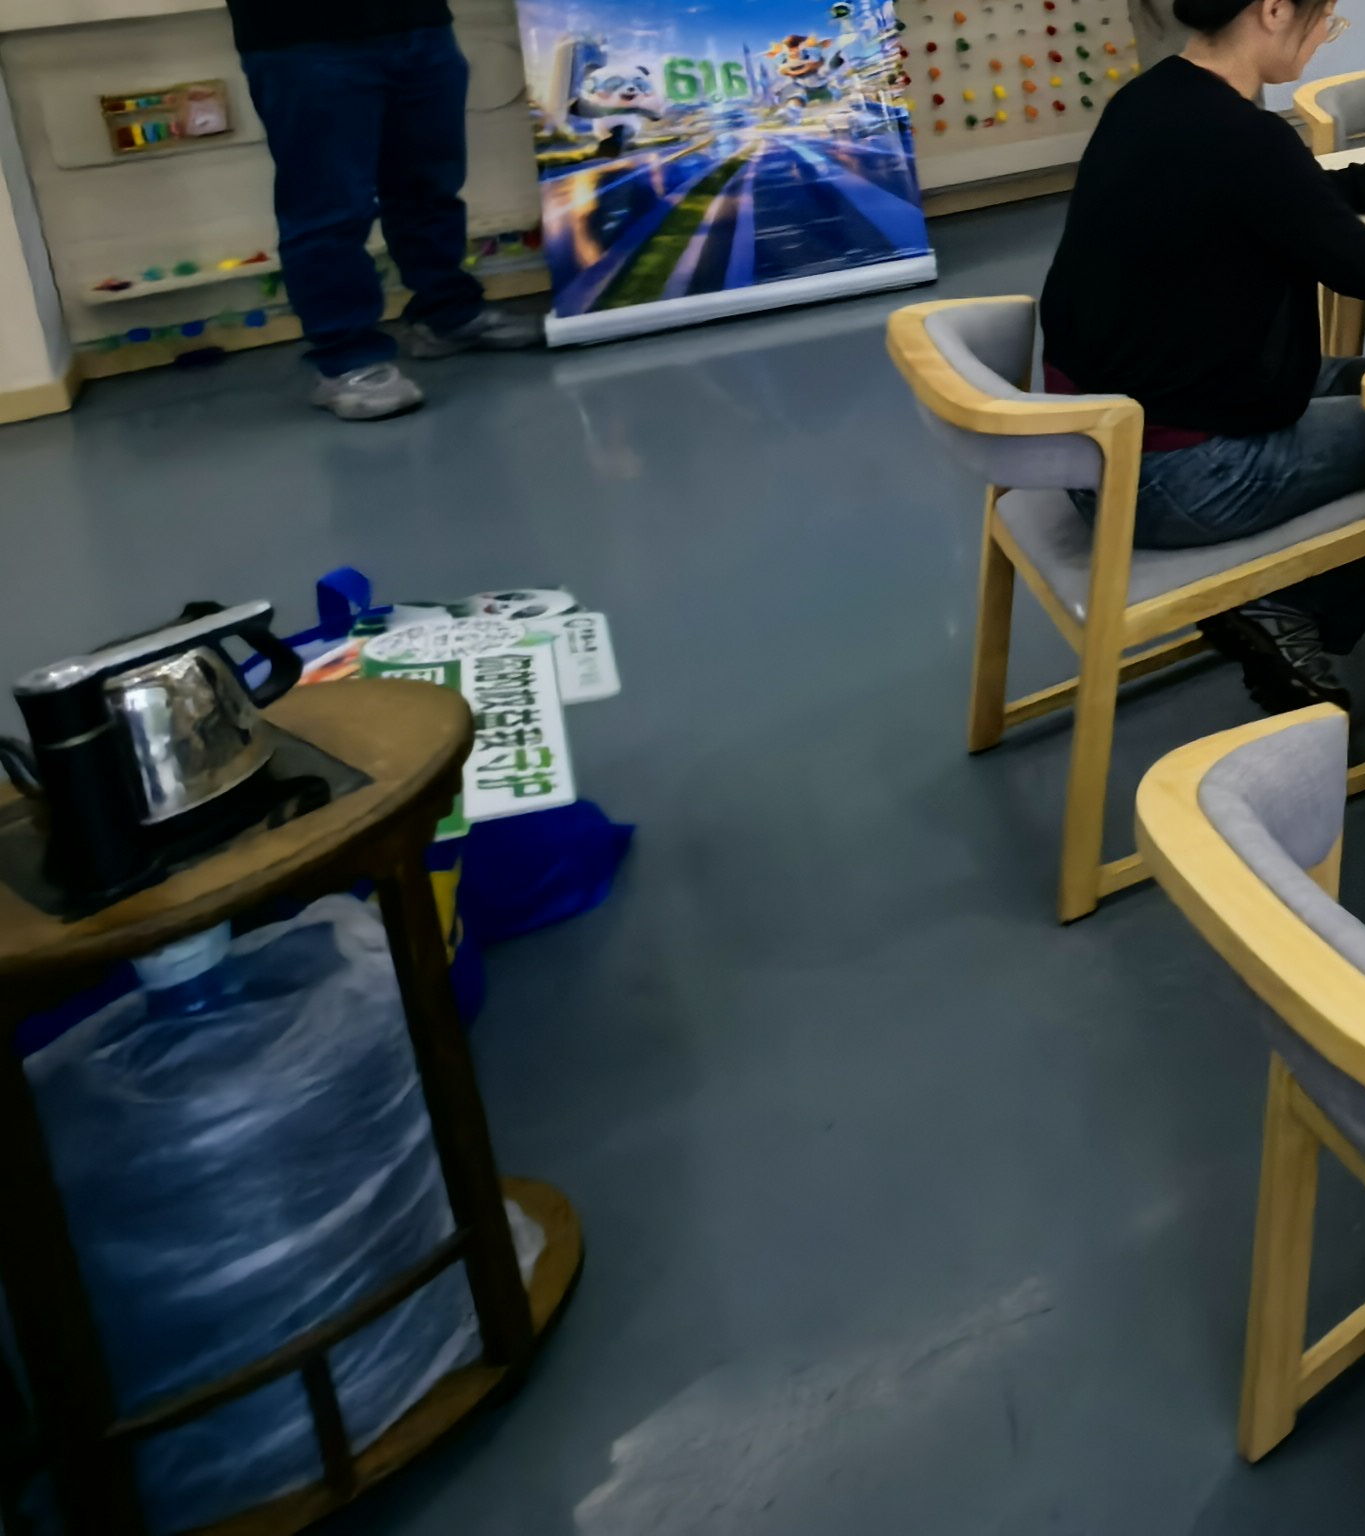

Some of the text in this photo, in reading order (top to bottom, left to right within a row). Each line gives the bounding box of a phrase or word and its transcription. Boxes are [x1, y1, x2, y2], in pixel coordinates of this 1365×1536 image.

[474, 654, 555, 797] 你的权益我守护
